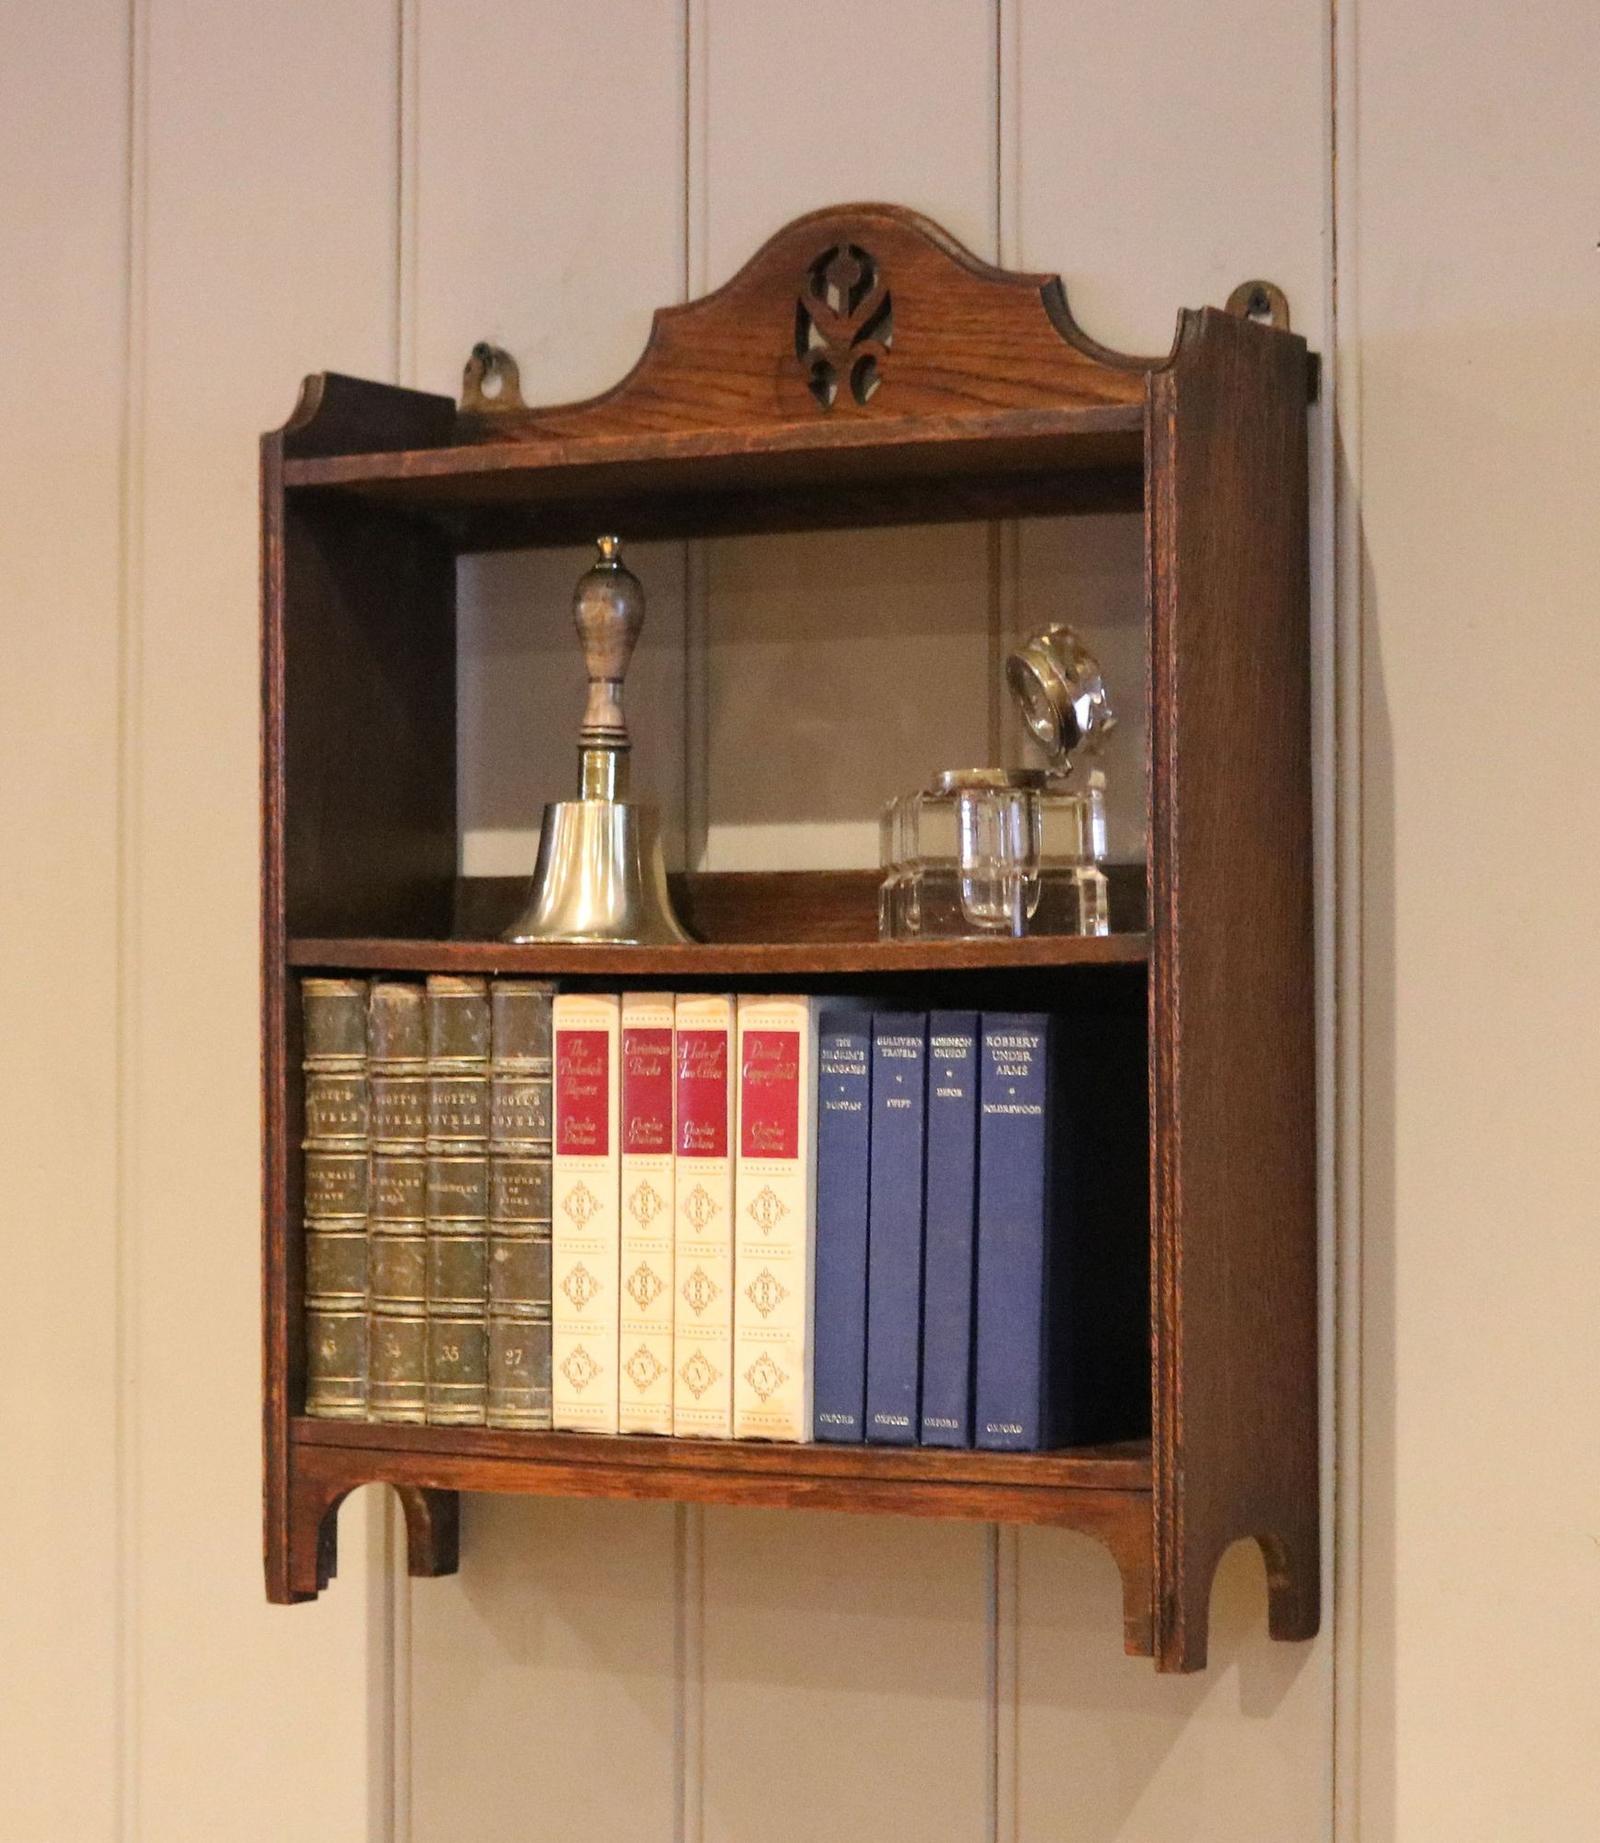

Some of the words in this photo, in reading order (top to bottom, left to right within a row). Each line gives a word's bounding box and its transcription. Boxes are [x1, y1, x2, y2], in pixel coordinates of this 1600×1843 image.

[876, 1035, 923, 1048] GULLIVER'S
[985, 1035, 1040, 1049] ROBBERY
[678, 1040, 689, 1059] A
[881, 1047, 918, 1059] TRAVELS
[991, 1050, 1033, 1062] UNDER
[995, 1064, 1029, 1077] ARMS
[432, 1092, 478, 1105] SCOTT'S
[495, 1094, 541, 1107] SCOTT'S
[427, 1114, 482, 1126] NOVELS
[492, 1114, 546, 1127] NOVELS
[441, 1345, 460, 1362] 35
[504, 1348, 523, 1366] 27
[819, 1412, 855, 1425] OXFORD
[874, 1413, 910, 1426] OXFORD
[923, 1416, 959, 1429] OXFORD
[986, 1422, 1024, 1434] OXFORD
